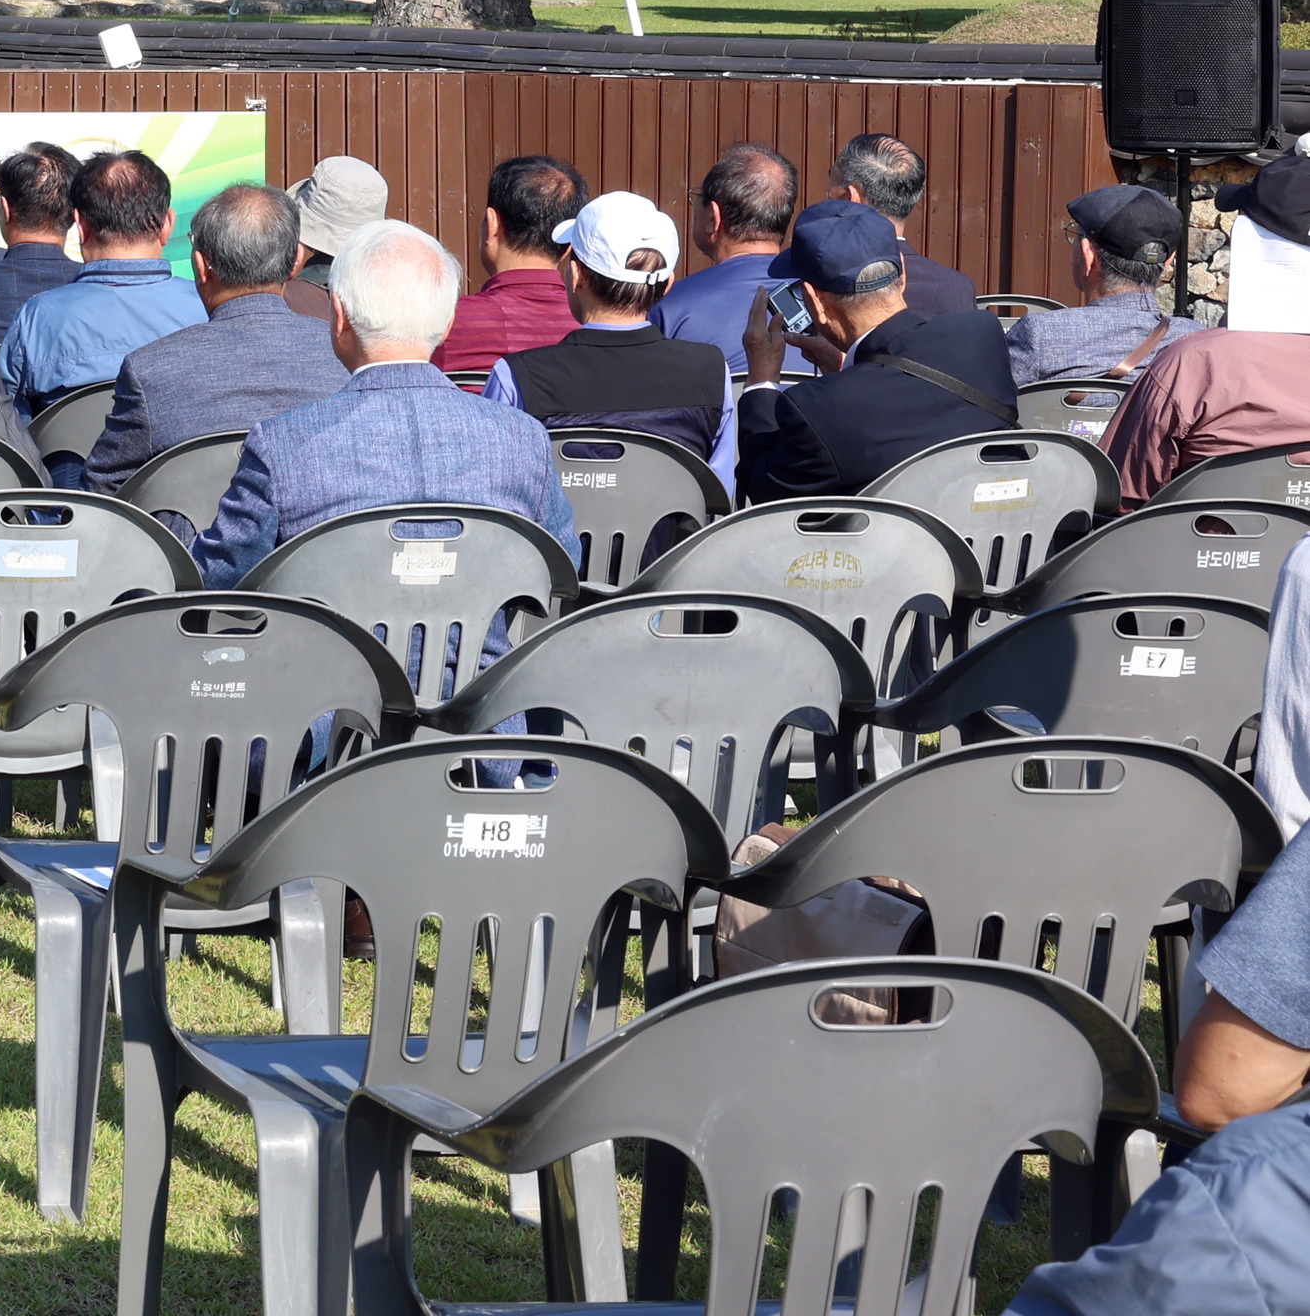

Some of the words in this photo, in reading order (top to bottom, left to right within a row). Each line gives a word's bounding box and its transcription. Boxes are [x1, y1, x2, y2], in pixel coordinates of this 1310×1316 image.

[561, 471, 618, 489] 남도이벤트
[1196, 549, 1261, 570] 남도이벤트
[480, 820, 511, 842] H8
